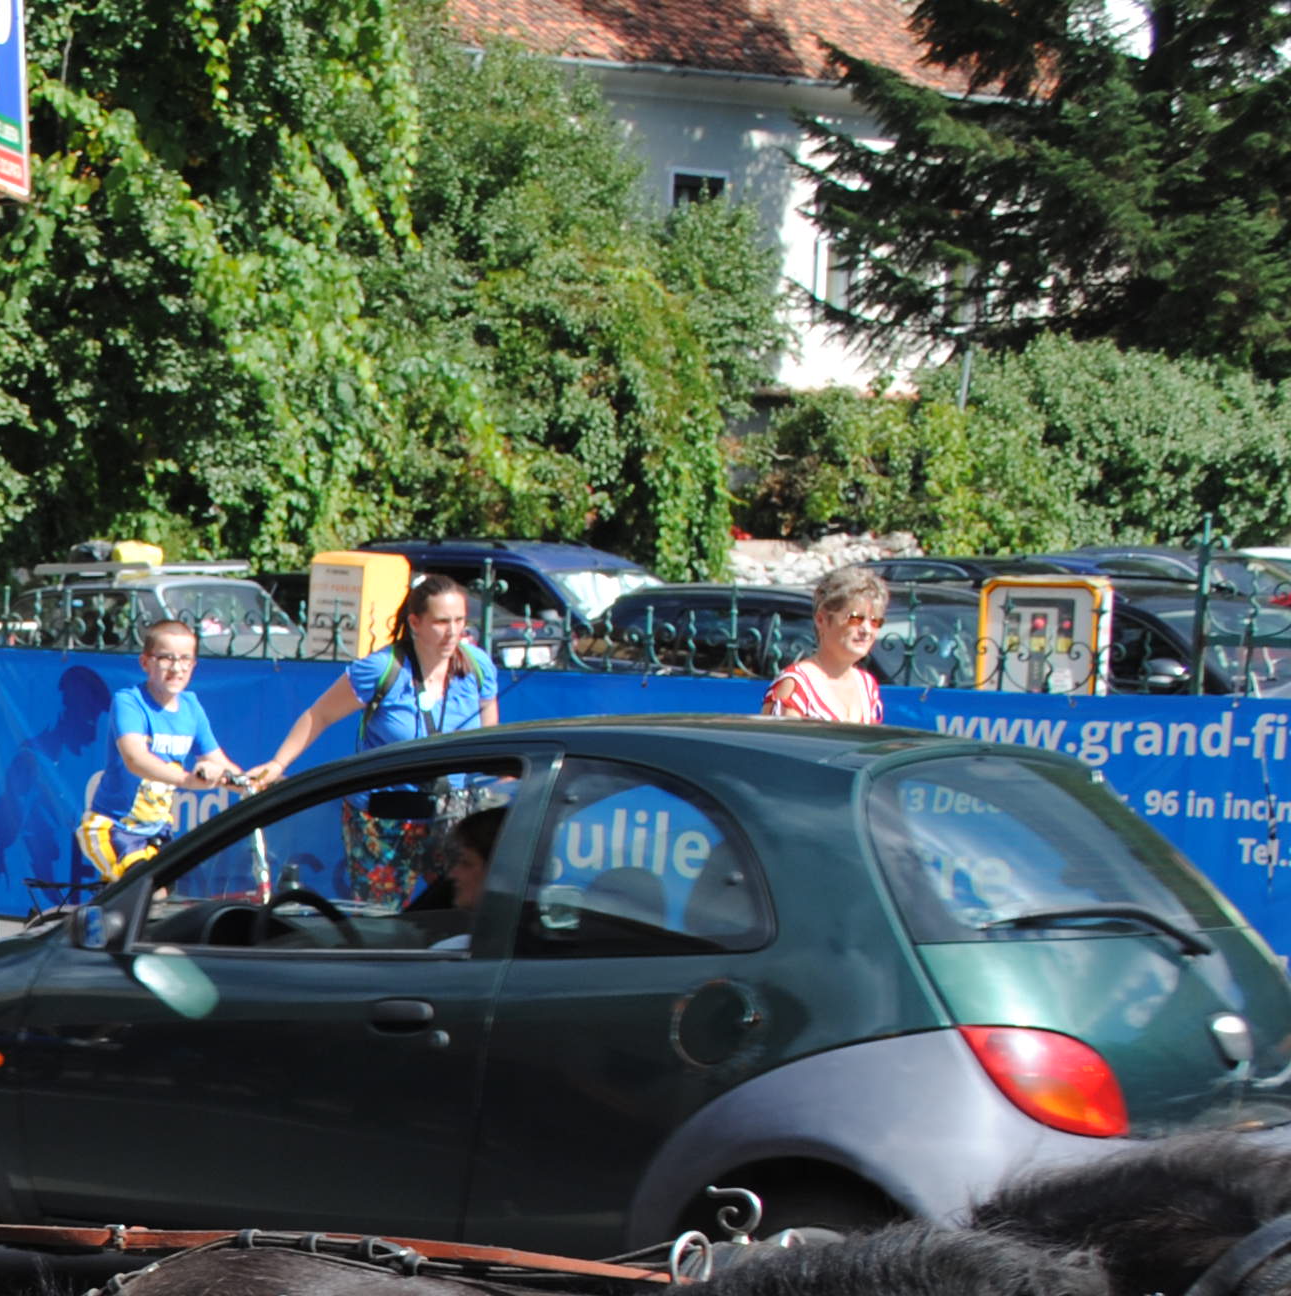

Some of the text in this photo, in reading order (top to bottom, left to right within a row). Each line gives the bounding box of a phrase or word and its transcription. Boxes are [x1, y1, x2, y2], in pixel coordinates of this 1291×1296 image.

[936, 711, 1291, 767] www.grand-fi
[1144, 788, 1179, 817] 96
[1187, 789, 1215, 818] in
